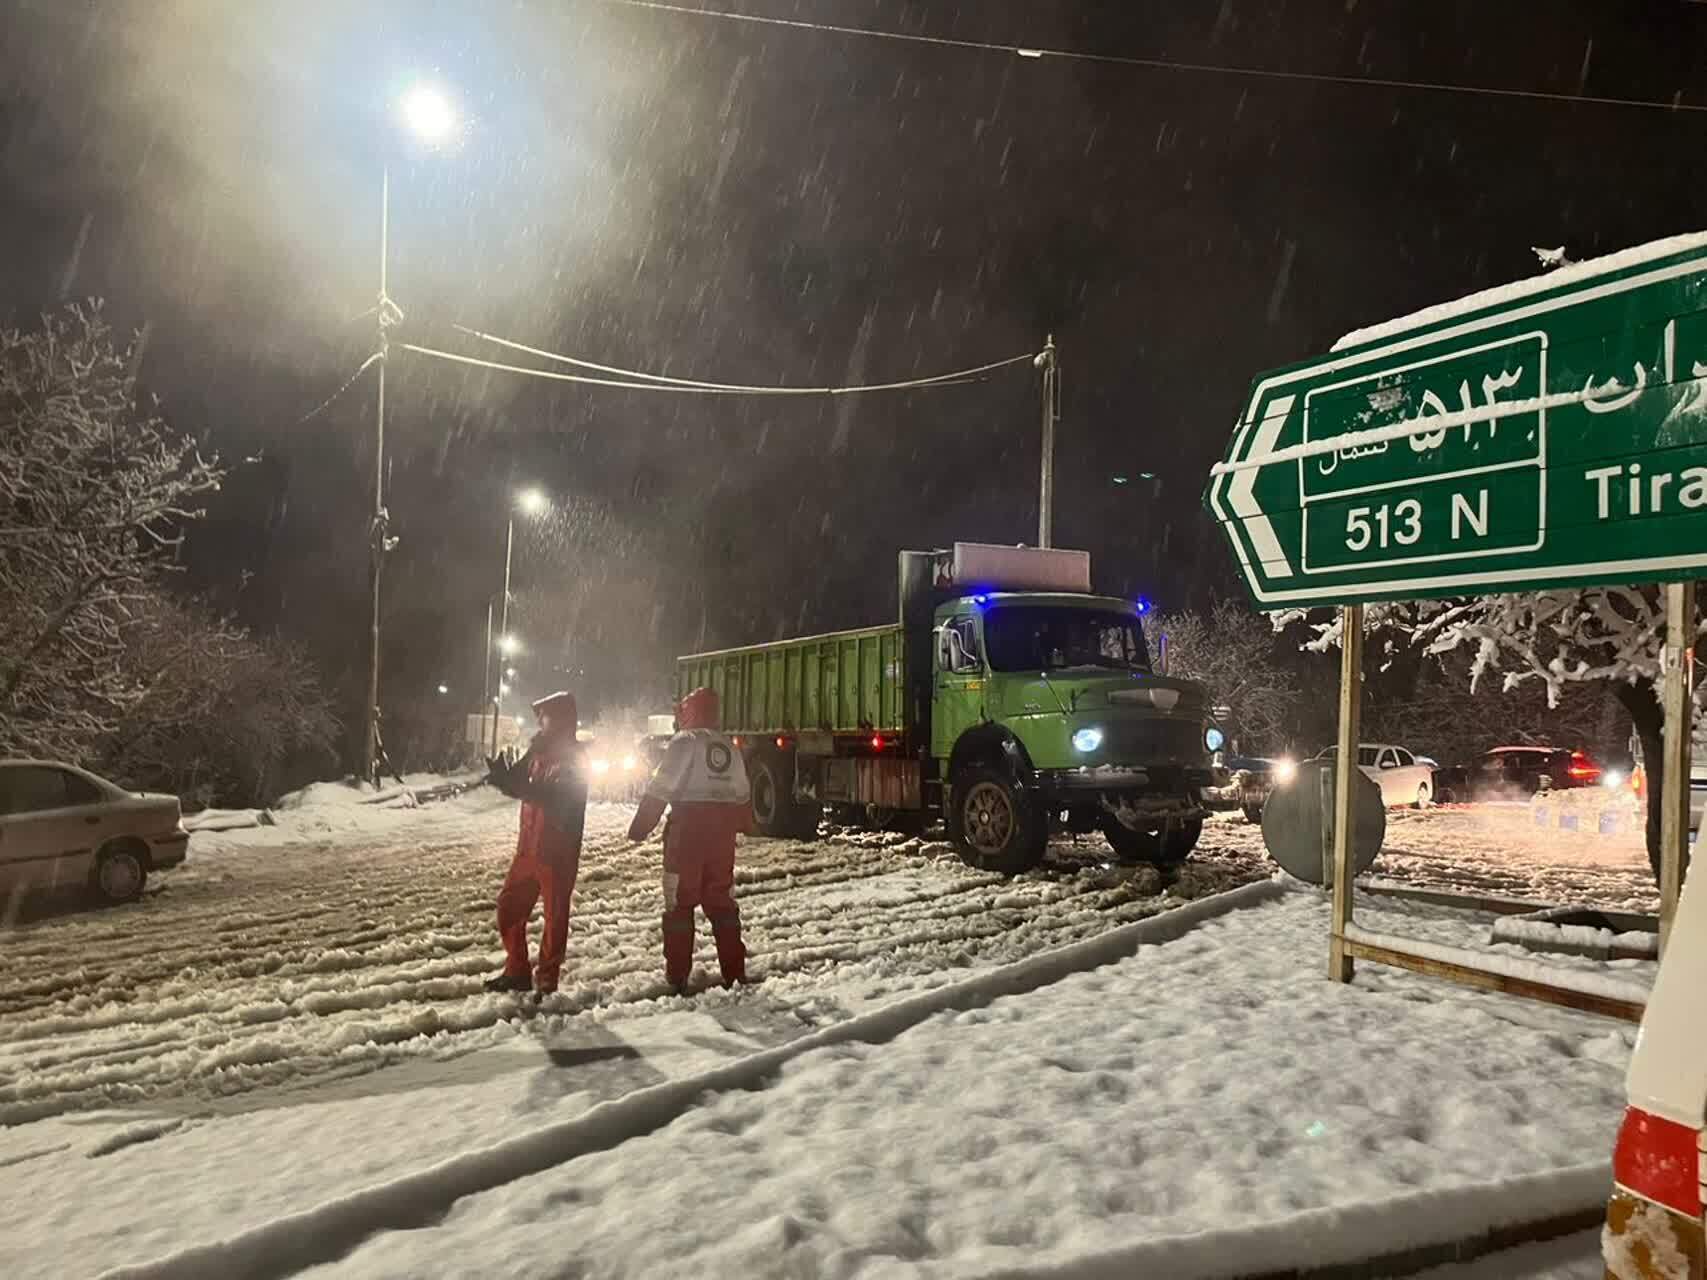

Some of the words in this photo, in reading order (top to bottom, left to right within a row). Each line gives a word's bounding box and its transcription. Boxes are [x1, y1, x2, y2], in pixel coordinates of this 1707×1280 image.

[1409, 366, 1523, 452] ۵۱۳
[1345, 499, 1422, 551] 513
[1451, 489, 1488, 539] N
[1585, 463, 1707, 519] Tira
